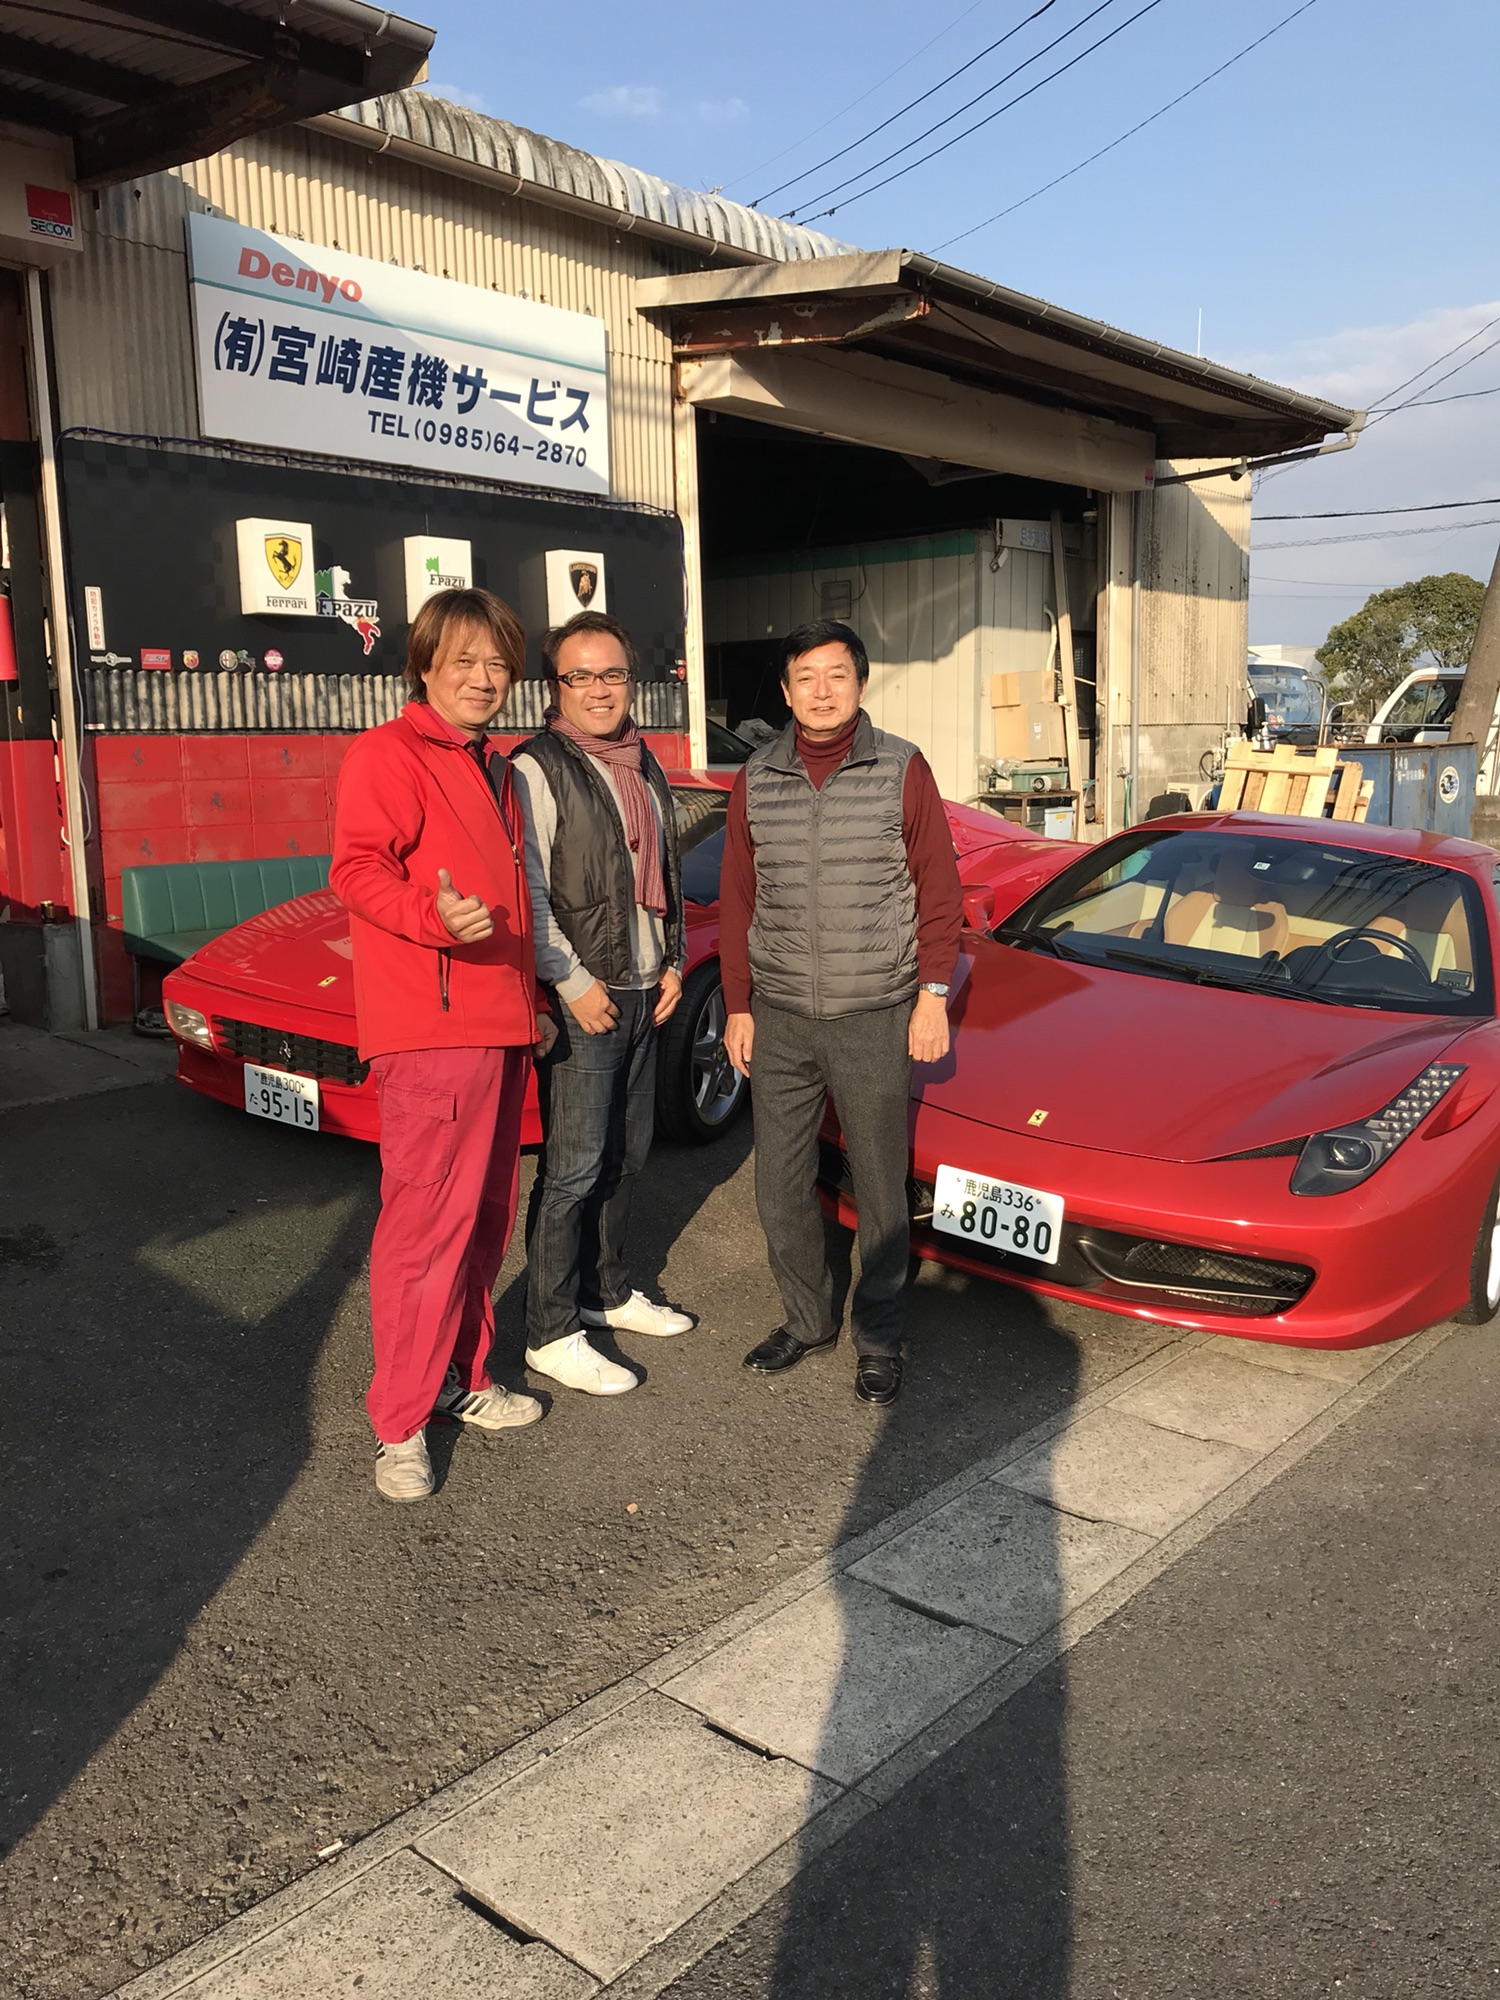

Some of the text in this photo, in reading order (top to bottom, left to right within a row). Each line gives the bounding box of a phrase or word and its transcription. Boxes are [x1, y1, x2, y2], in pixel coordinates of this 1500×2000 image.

[31, 219, 72, 238] SECOM
[237, 247, 362, 304] Denyo
[214, 311, 590, 433] (有)宮崎産機サービス
[266, 595, 308, 609] Ferrari
[249, 1088, 314, 1126] た 95-15
[940, 1200, 1052, 1255] み 80-80
